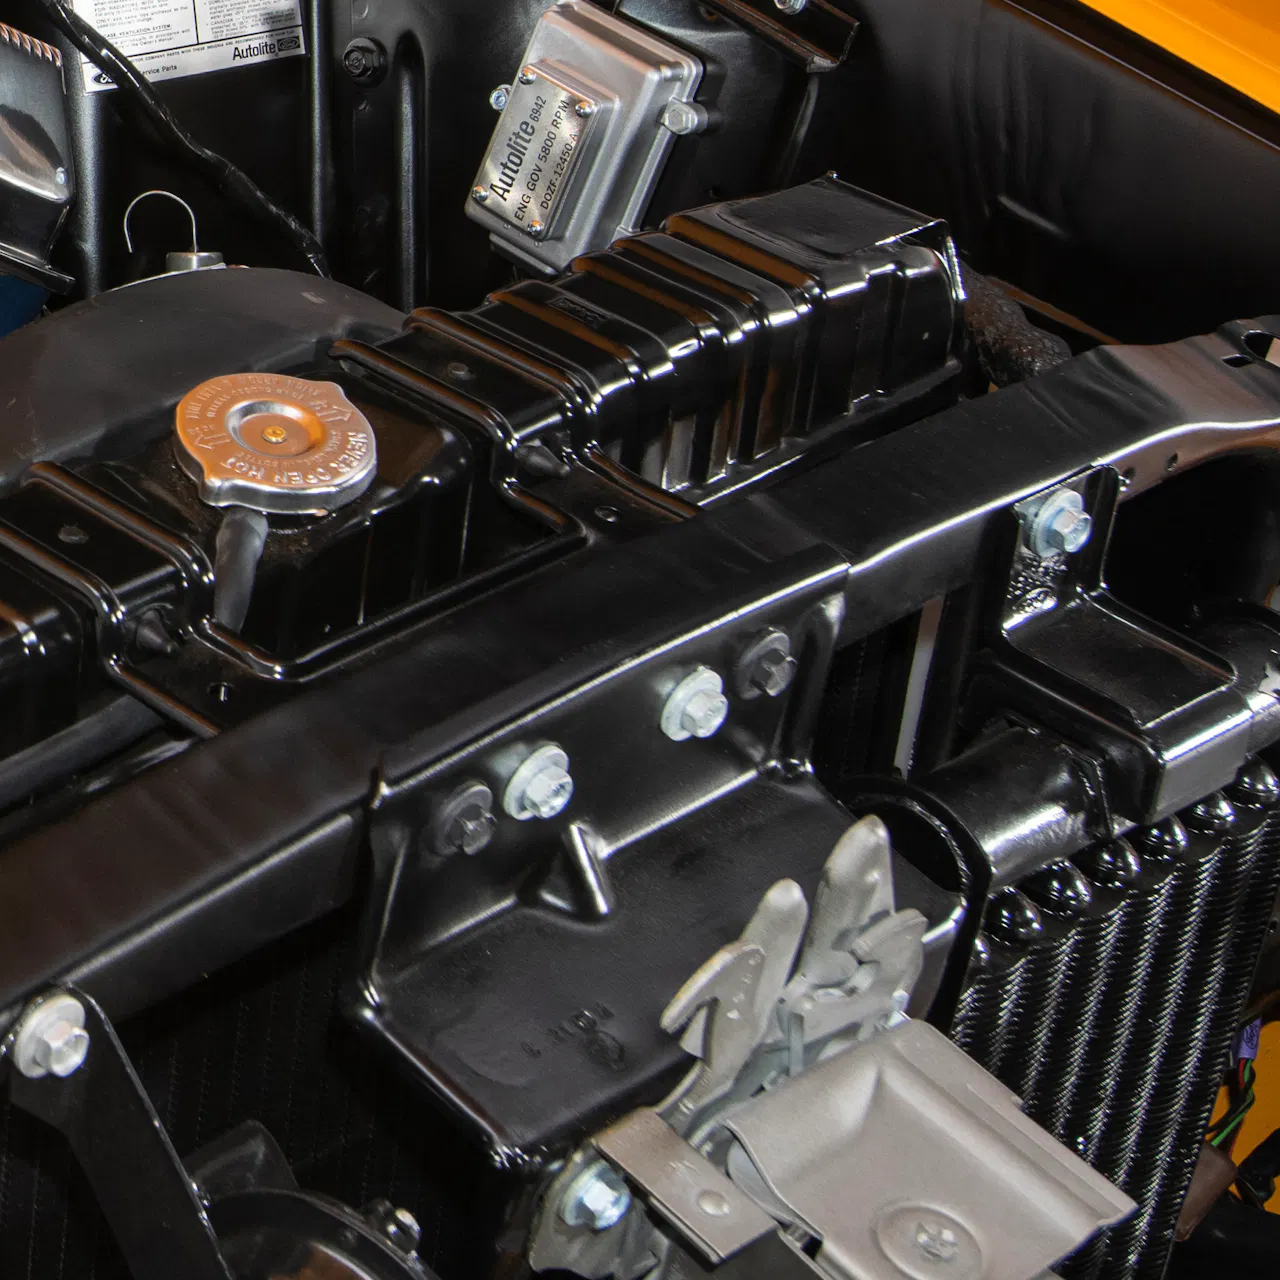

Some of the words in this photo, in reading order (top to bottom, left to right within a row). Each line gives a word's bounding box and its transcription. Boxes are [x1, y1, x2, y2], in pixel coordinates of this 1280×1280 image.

[231, 39, 276, 61] Autolite
[141, 67, 159, 75] ervice
[161, 63, 177, 72] Parts
[490, 120, 535, 202] Autolite
[530, 96, 546, 123] 6942
[514, 194, 532, 221] ENG
[527, 163, 542, 192] GOV
[538, 131, 557, 163] 5800
[551, 100, 570, 129] RPM
[329, 431, 368, 472] NEVER
[219, 457, 265, 480] HOT
[273, 467, 332, 485] OPEN
